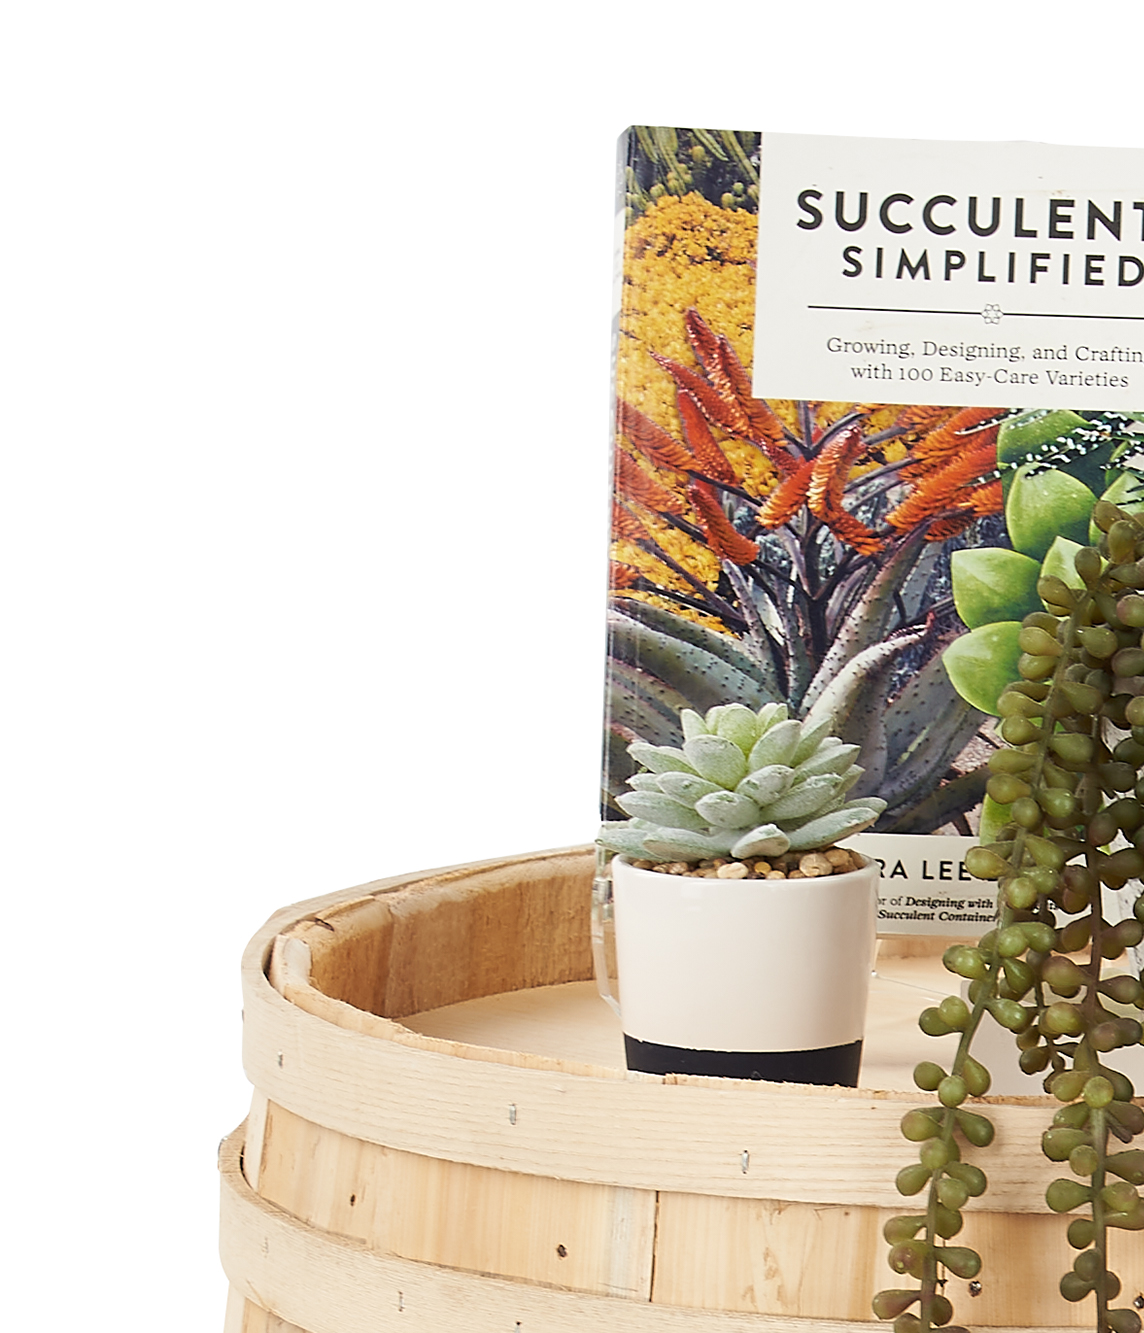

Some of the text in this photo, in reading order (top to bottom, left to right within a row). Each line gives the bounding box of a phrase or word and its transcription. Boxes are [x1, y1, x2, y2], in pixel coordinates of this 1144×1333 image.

[826, 336, 915, 360] Growing,
[922, 339, 1026, 363] Designing,
[1032, 341, 1068, 362] and
[850, 361, 1130, 390] with 100 Easy-Care Varieties
[923, 860, 972, 881] LEE
[890, 896, 902, 906] of
[905, 897, 966, 910] Designing
[968, 899, 993, 909] with
[878, 910, 936, 922] Succulent
